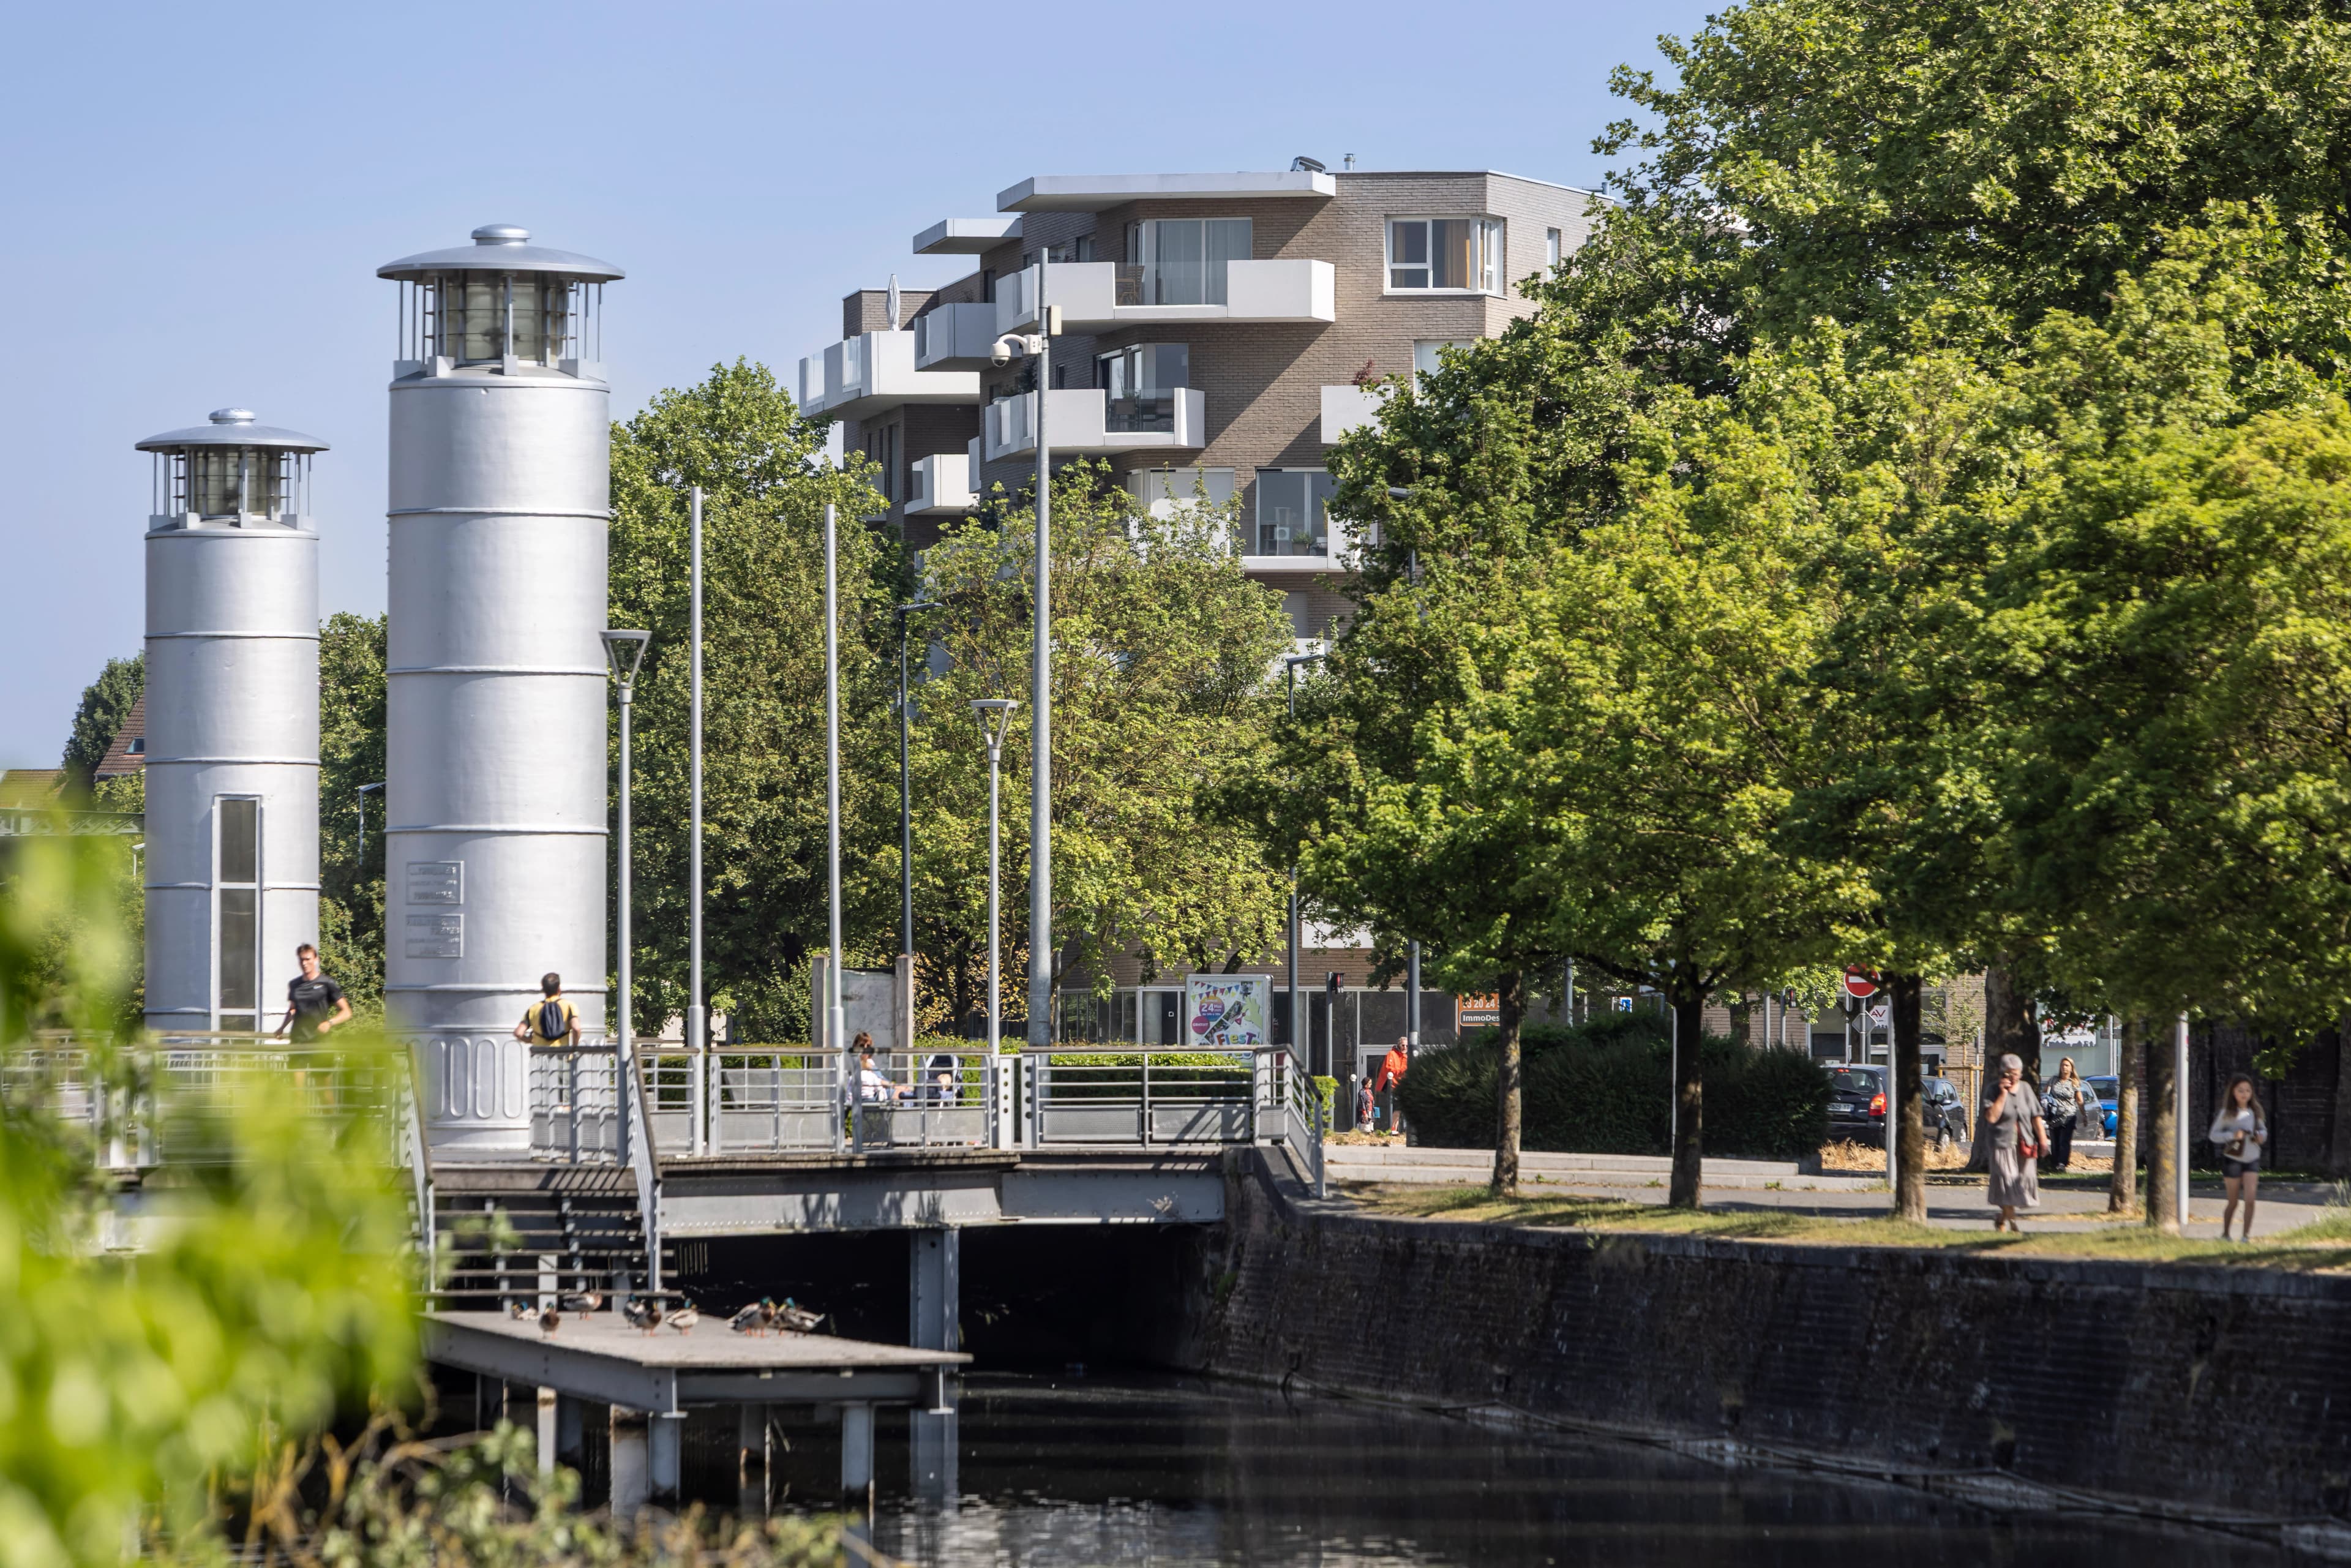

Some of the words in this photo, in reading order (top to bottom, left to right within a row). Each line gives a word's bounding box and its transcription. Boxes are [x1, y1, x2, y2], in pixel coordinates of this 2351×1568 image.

[1201, 1003, 1214, 1012] 24
[1463, 999, 1472, 1008] 3
[1474, 999, 1483, 1008] 20
[1485, 999, 1495, 1008] 24
